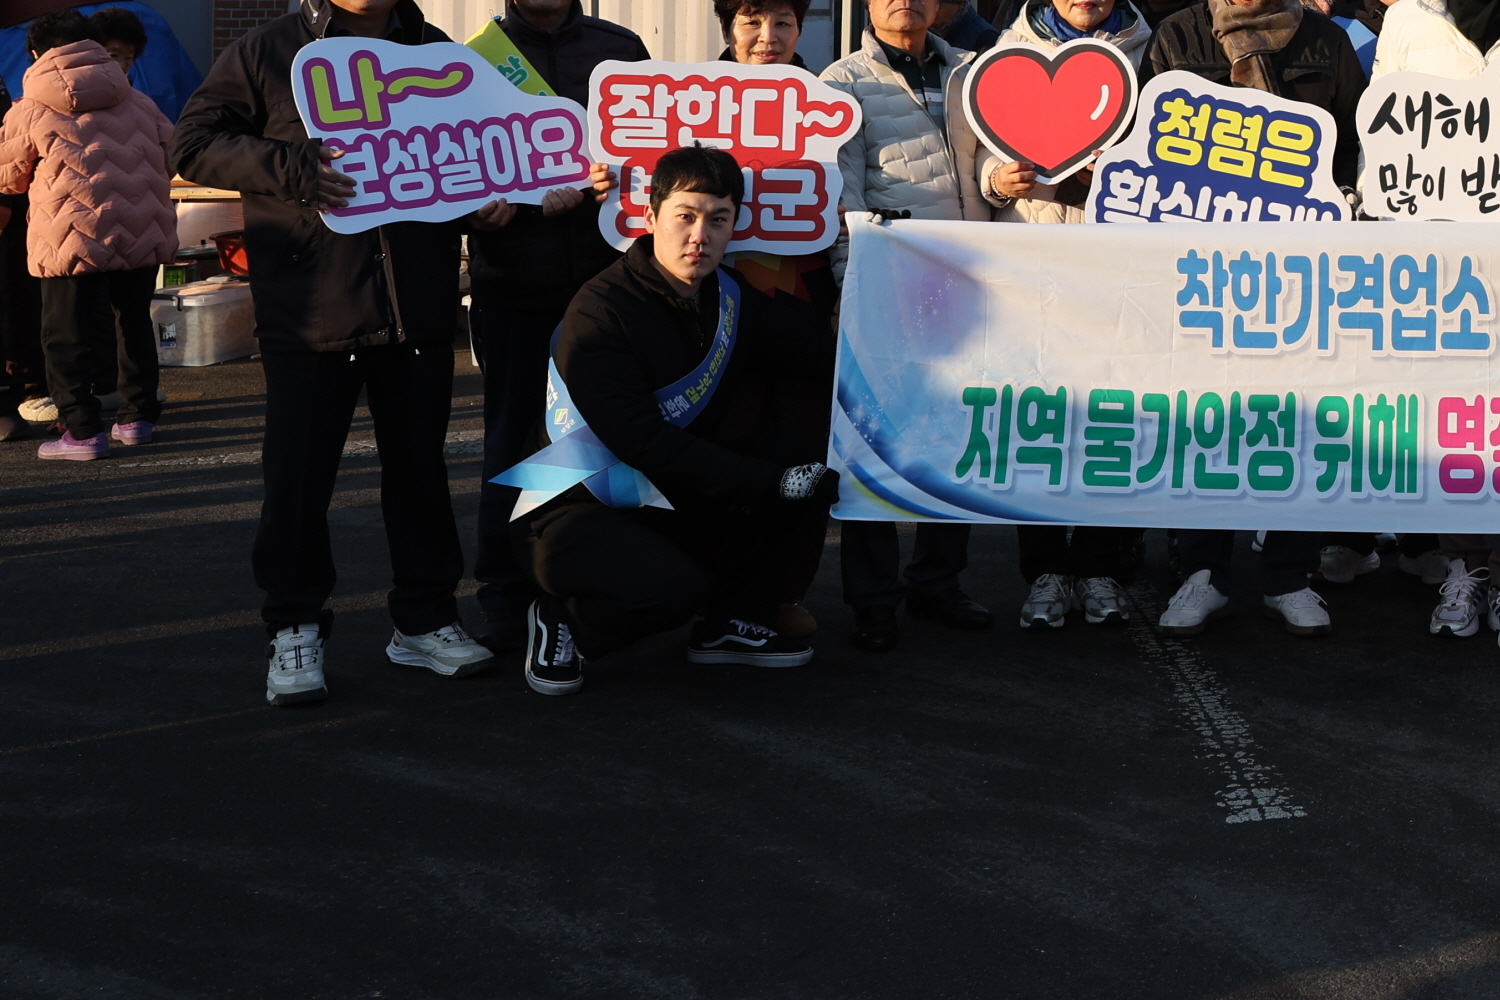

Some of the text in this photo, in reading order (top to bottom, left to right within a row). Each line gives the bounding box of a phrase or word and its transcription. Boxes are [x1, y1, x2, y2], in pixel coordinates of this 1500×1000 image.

[328, 117, 584, 208] 보성살아요
[1155, 97, 1315, 188] 청렴은
[1367, 90, 1490, 150] 새해
[1379, 153, 1446, 216] 많이
[1176, 248, 1491, 352] 착한가격업소
[955, 385, 1068, 486] 지역
[1082, 389, 1297, 492] 물가안정
[1315, 393, 1419, 495] 위해
